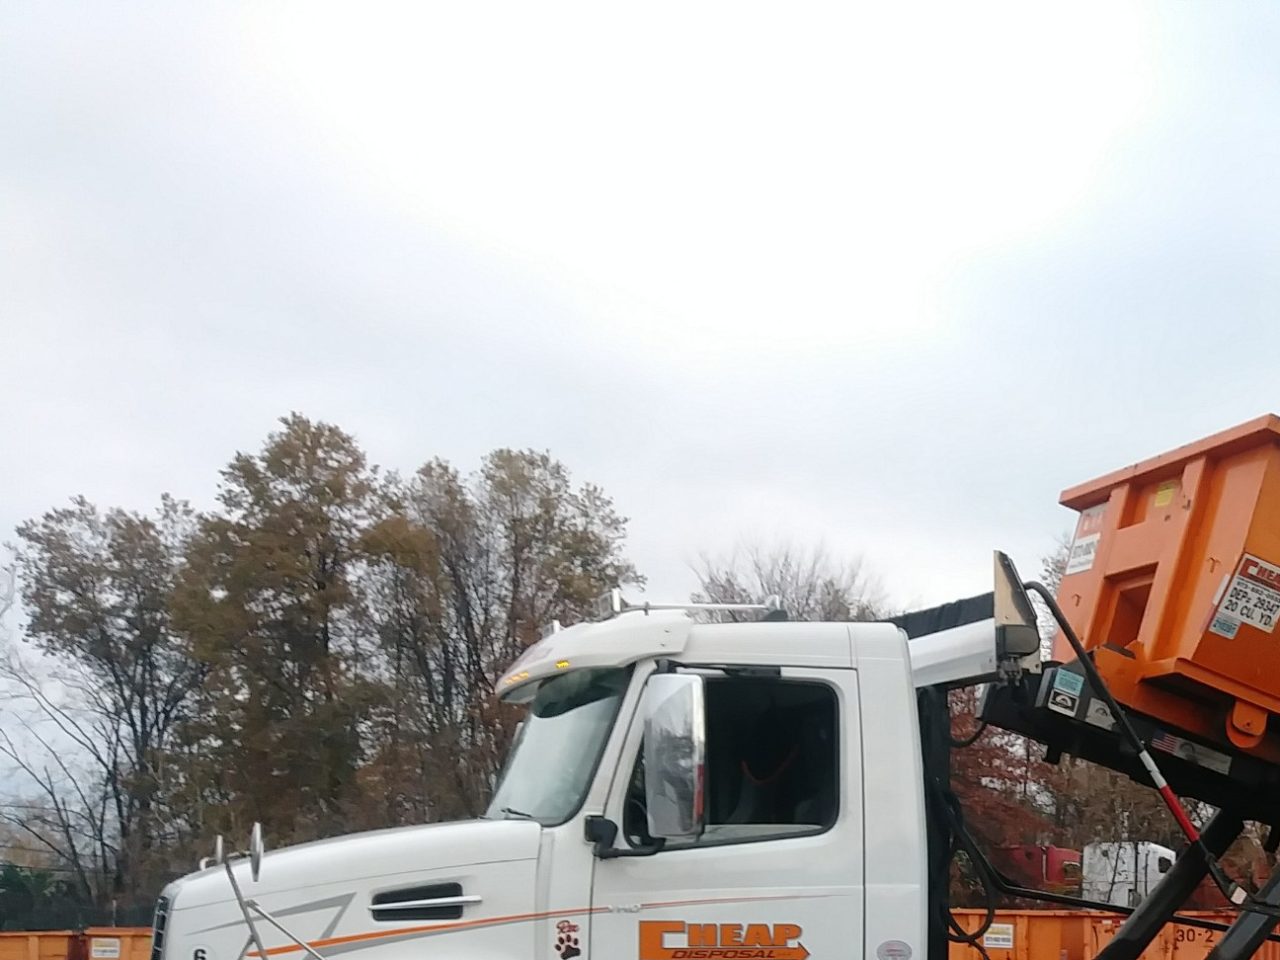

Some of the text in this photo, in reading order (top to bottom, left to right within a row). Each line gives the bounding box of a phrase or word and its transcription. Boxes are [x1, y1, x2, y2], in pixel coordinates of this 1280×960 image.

[1225, 599, 1239, 612] 20
[639, 920, 803, 960] CHEAP
[671, 949, 777, 959] DISPOSAL
